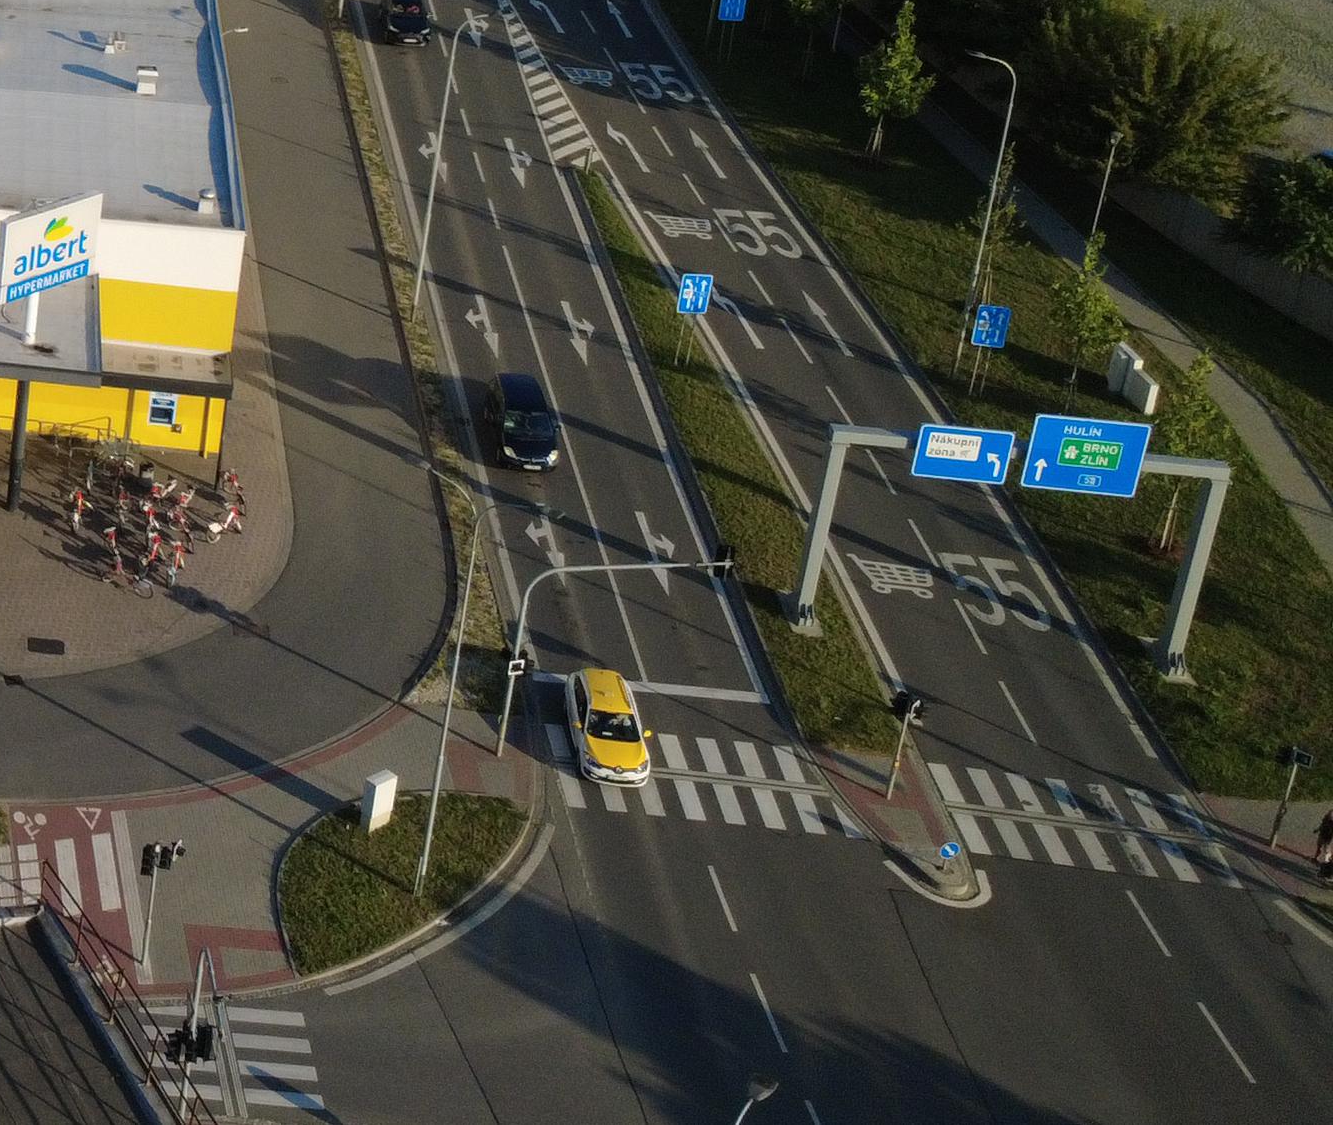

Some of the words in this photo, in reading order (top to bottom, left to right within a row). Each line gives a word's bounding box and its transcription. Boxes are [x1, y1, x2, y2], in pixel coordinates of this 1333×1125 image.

[619, 62, 694, 102] 55
[713, 207, 802, 259] 55
[14, 230, 88, 276] albert
[9, 263, 86, 299] HYPERMARKET
[1063, 424, 1103, 437] HULÍN
[1082, 442, 1119, 455] BRNO
[1079, 452, 1109, 466] ZLÍN
[937, 552, 1052, 632] 55
